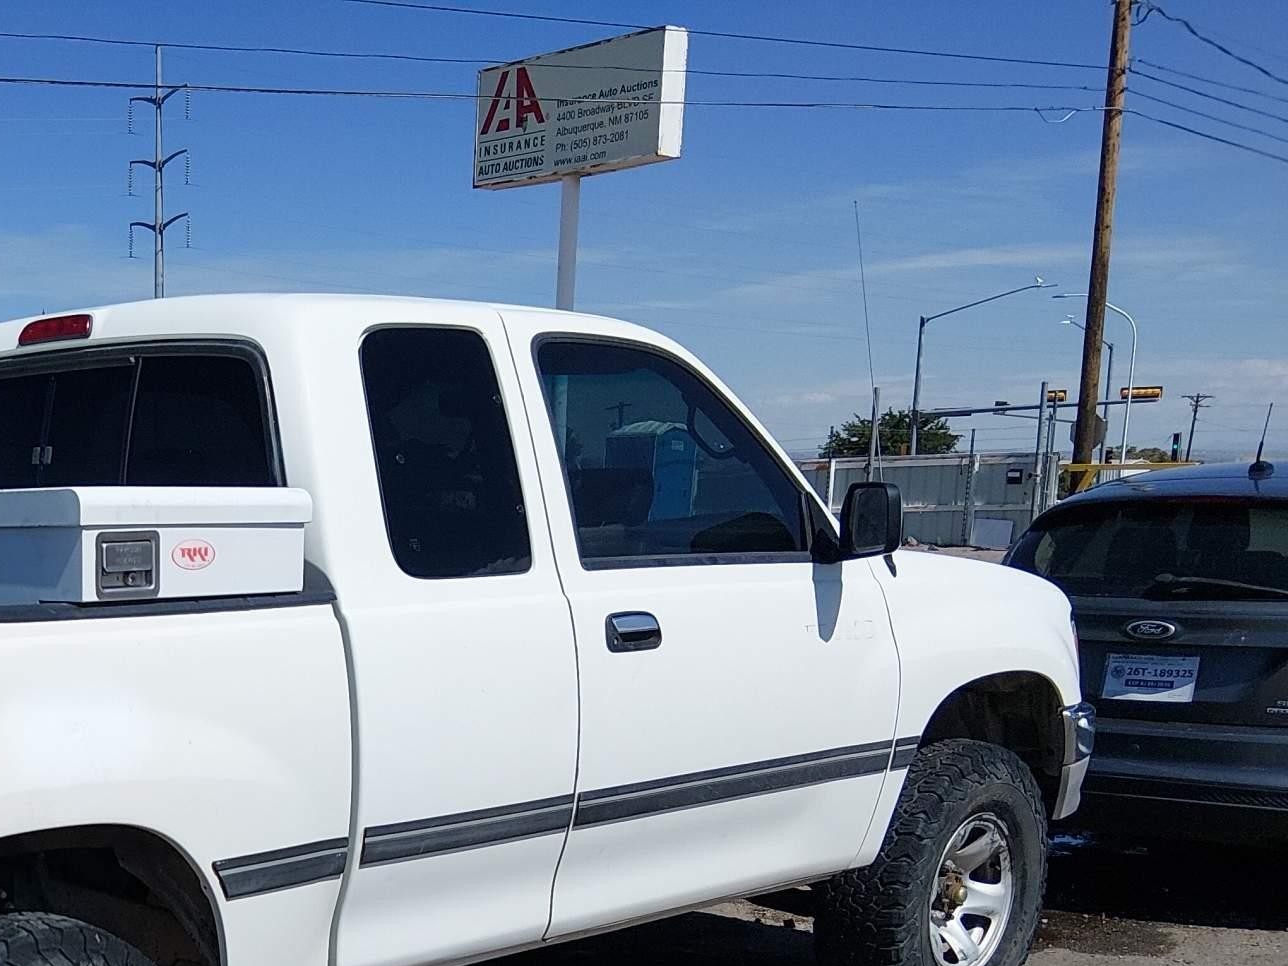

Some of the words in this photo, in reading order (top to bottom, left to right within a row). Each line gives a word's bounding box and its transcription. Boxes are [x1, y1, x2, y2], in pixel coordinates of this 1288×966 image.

[557, 92, 597, 109] Insurance
[598, 88, 618, 99] Auto
[619, 79, 659, 94] Auctions
[556, 110, 576, 122] 4400
[577, 104, 615, 119] Broadway
[608, 114, 622, 125] NM
[624, 109, 649, 124] 87105
[479, 135, 546, 158] INSURANCE
[555, 142, 567, 153] Ph:
[570, 138, 591, 152] (505)
[592, 129, 629, 145] 873-2081
[478, 162, 501, 177] AUTO
[502, 154, 545, 173] AUCTIONS
[553, 150, 607, 167] www.iaai.com
[1126, 667, 1194, 678] 26T-189325
